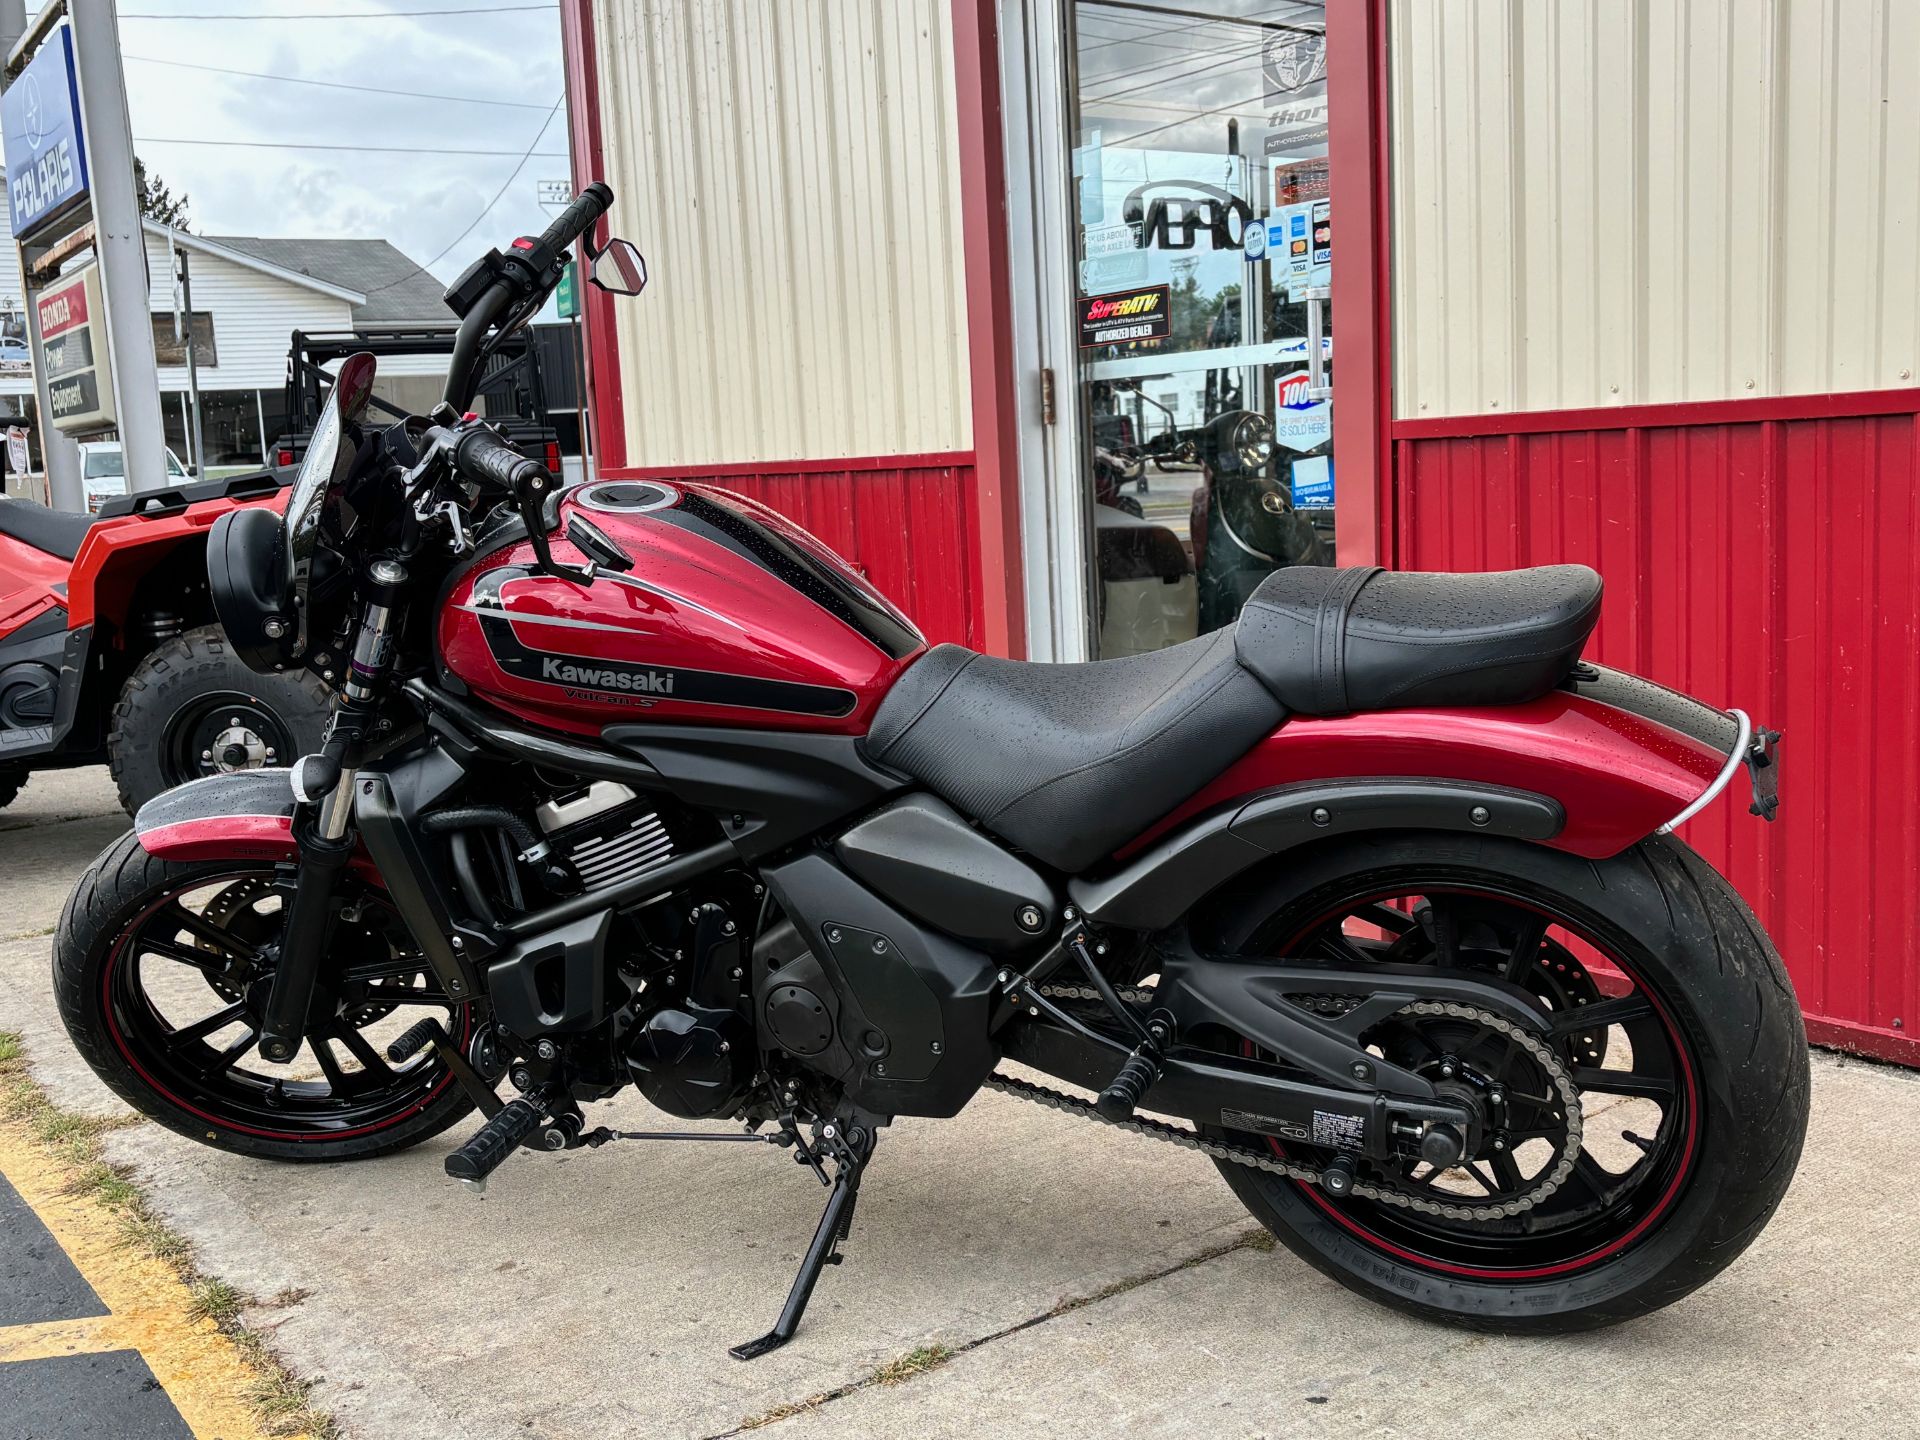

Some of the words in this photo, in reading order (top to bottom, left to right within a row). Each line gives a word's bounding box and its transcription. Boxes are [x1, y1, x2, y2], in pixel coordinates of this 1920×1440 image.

[13, 137, 73, 224] POLARIS
[1107, 229, 1128, 241] ABOUT
[1316, 250, 1331, 260] VISA
[1293, 263, 1307, 273] VISA
[41, 297, 71, 332] HONDA
[1094, 327, 1130, 343] AUTHORIZED
[1130, 324, 1153, 339] DEALER
[45, 346, 64, 371] Power
[51, 380, 83, 415] Equipment
[1283, 381, 1314, 406] 100
[1280, 425, 1287, 437] IS
[1287, 424, 1307, 437] SOLD
[1308, 422, 1327, 435] HERE
[542, 657, 674, 693] Kawasaki
